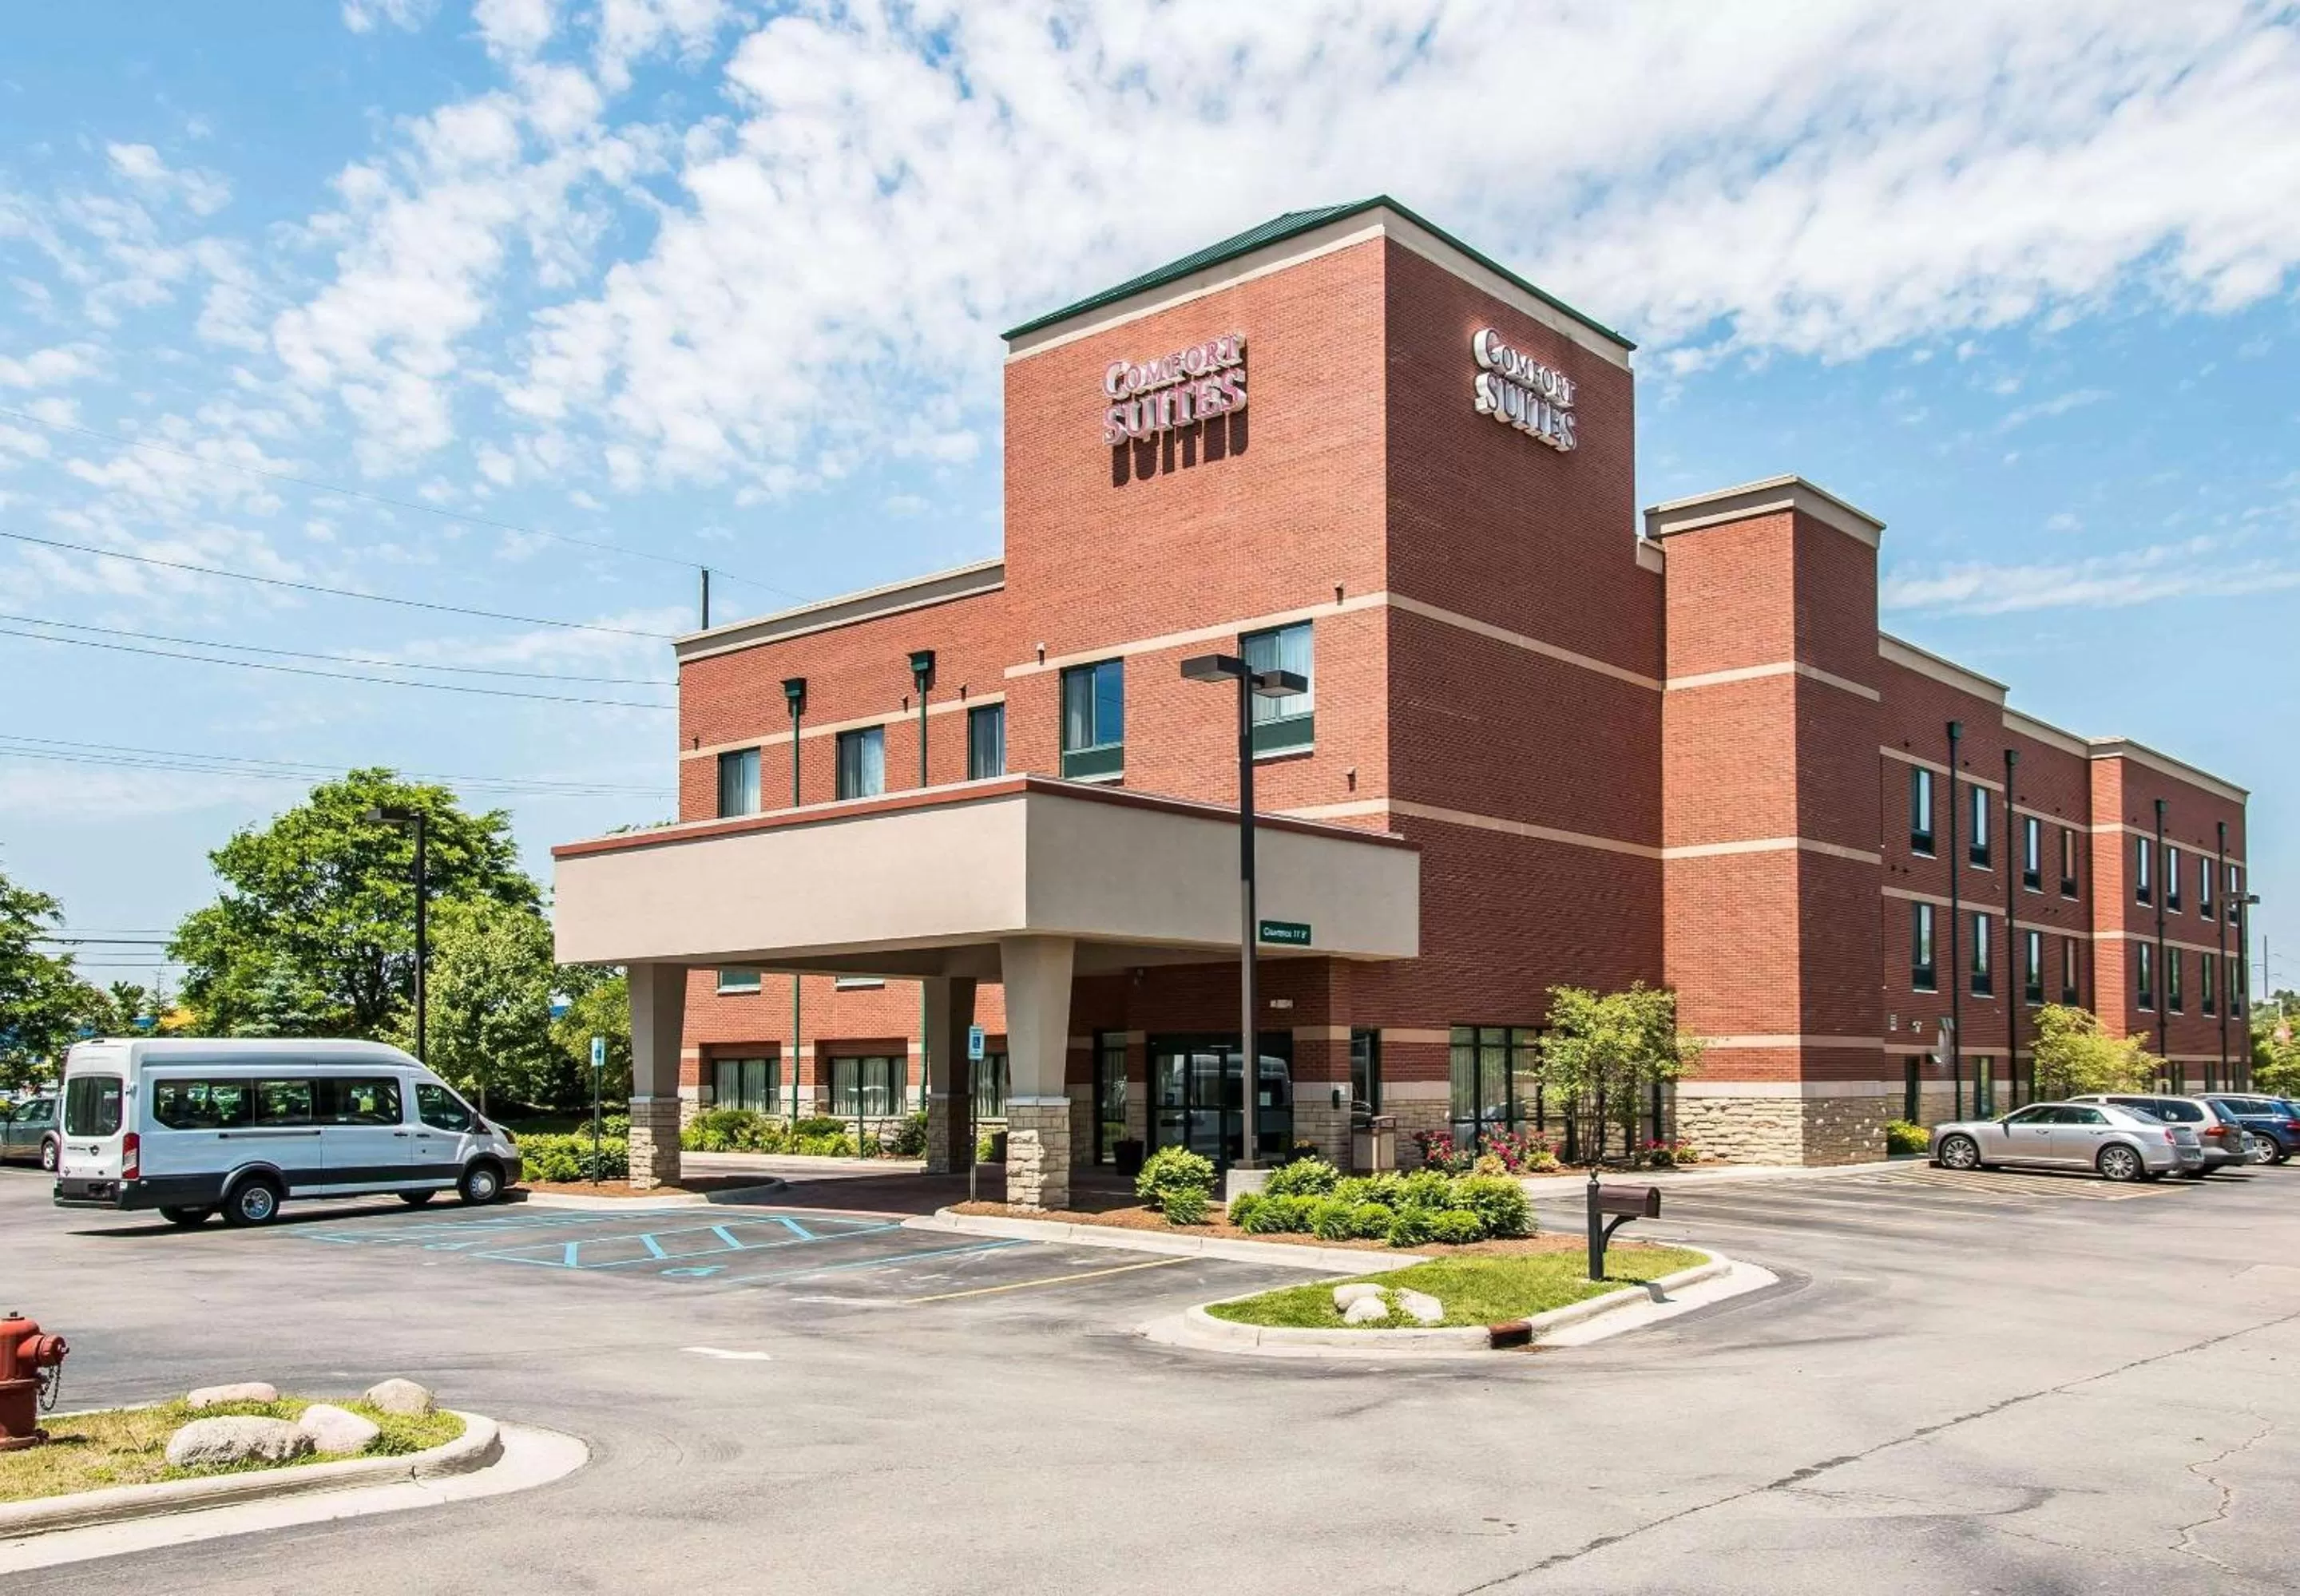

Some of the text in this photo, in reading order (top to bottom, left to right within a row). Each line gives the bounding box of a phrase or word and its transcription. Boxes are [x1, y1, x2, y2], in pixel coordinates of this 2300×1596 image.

[1102, 332, 1246, 401] COMFORT
[1102, 367, 1247, 446] SUITES
[1473, 328, 1576, 409] COMFORT
[1475, 371, 1577, 452] SUITES
